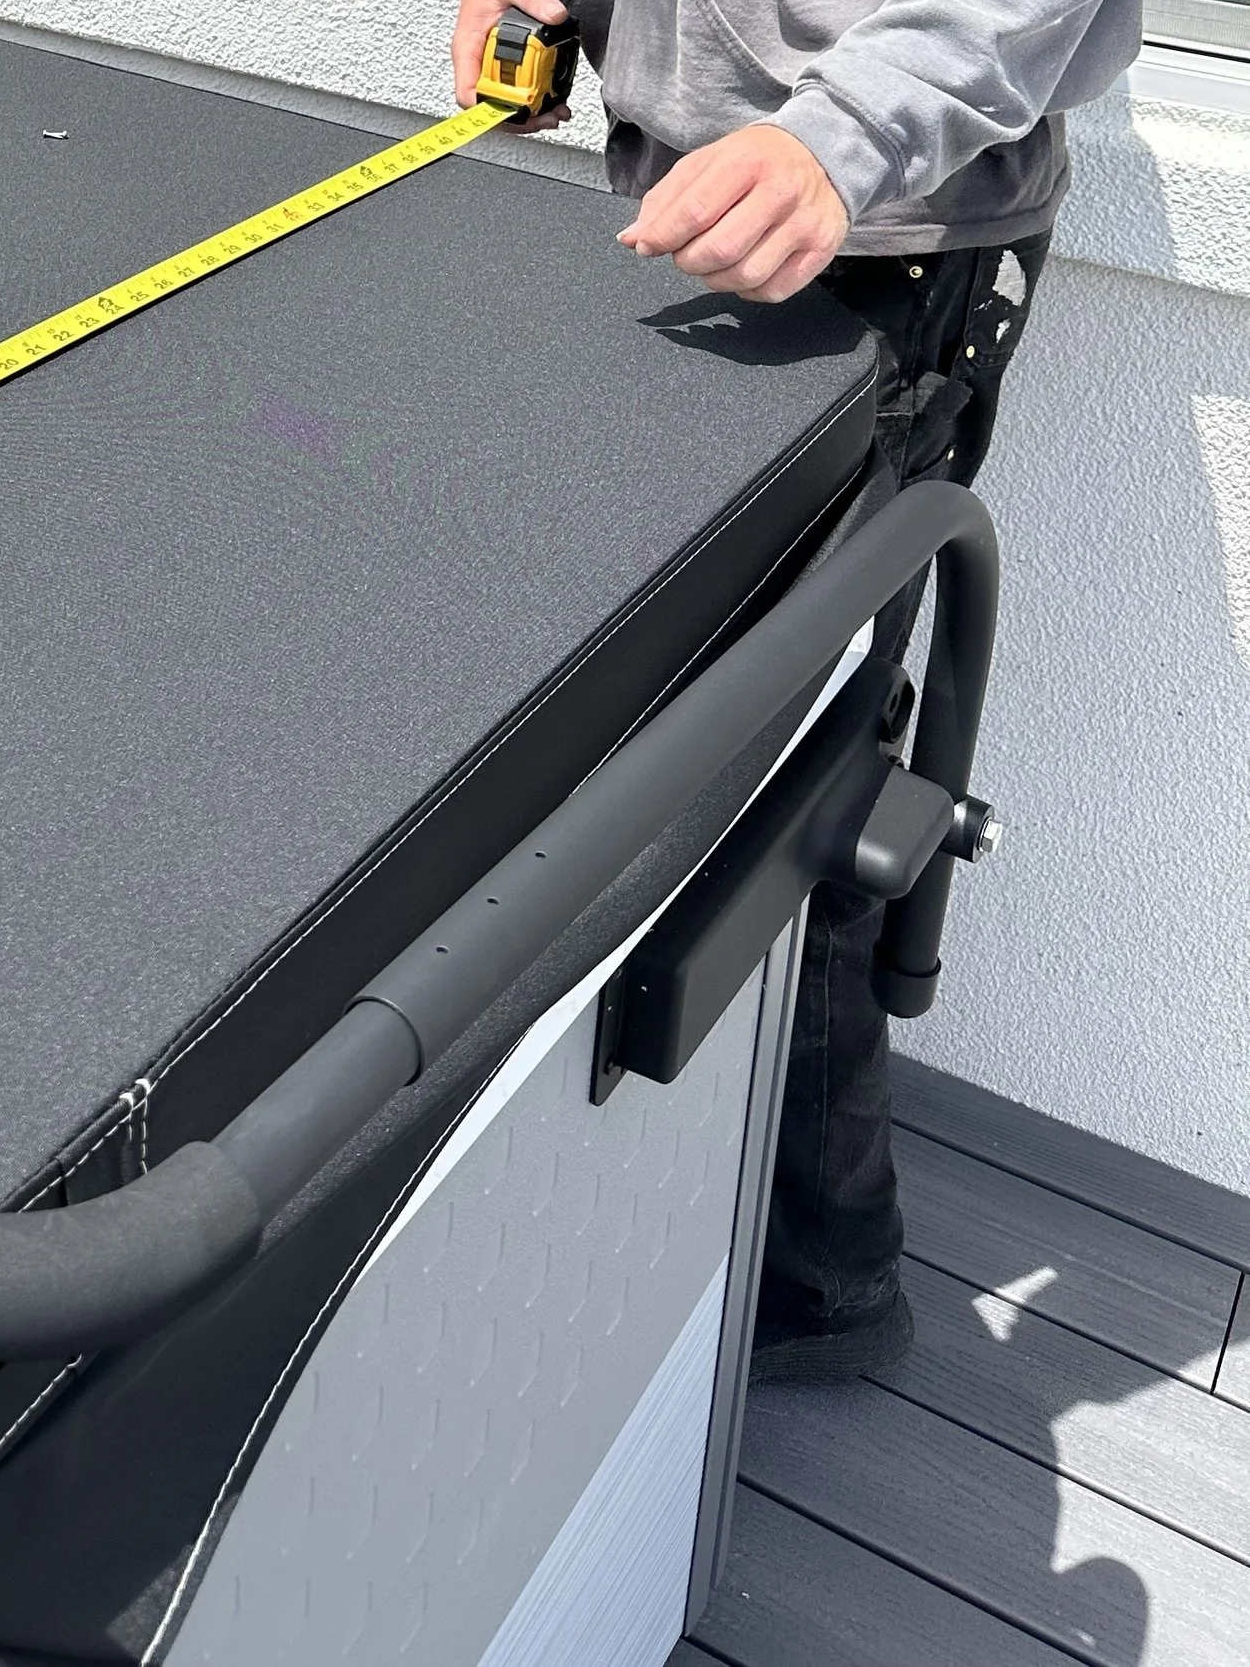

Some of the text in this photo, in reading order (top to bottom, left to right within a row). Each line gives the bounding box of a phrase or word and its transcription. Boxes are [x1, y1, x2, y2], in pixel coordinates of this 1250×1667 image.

[26, 344, 46, 355] 21
[53, 330, 73, 341] 22
[79, 317, 100, 328] 23
[106, 305, 125, 315] 24
[130, 291, 150, 302] 25
[154, 279, 175, 290] 26
[178, 267, 196, 278] 27
